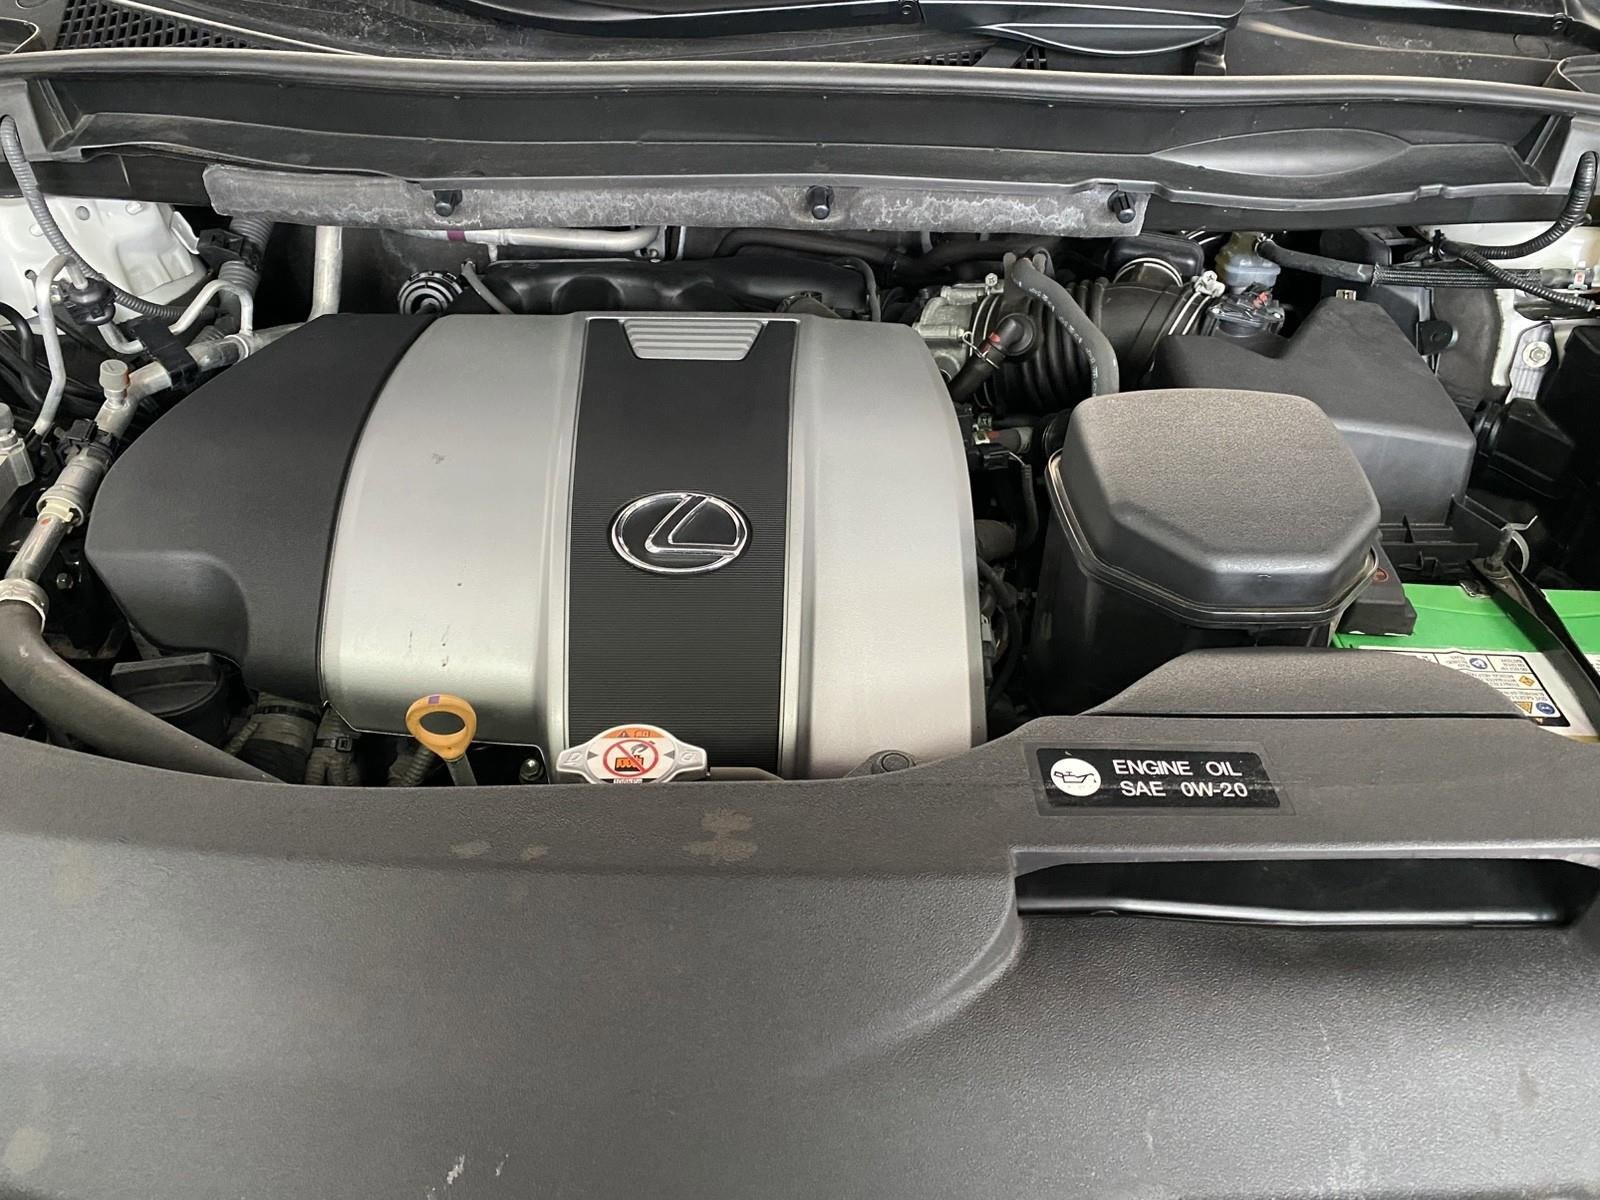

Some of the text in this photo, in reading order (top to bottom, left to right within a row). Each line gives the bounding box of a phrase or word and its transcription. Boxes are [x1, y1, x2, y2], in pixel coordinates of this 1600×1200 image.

[1112, 759, 1243, 777] ENGINE OIL
[1120, 780, 1249, 798] SAE 0W-20
